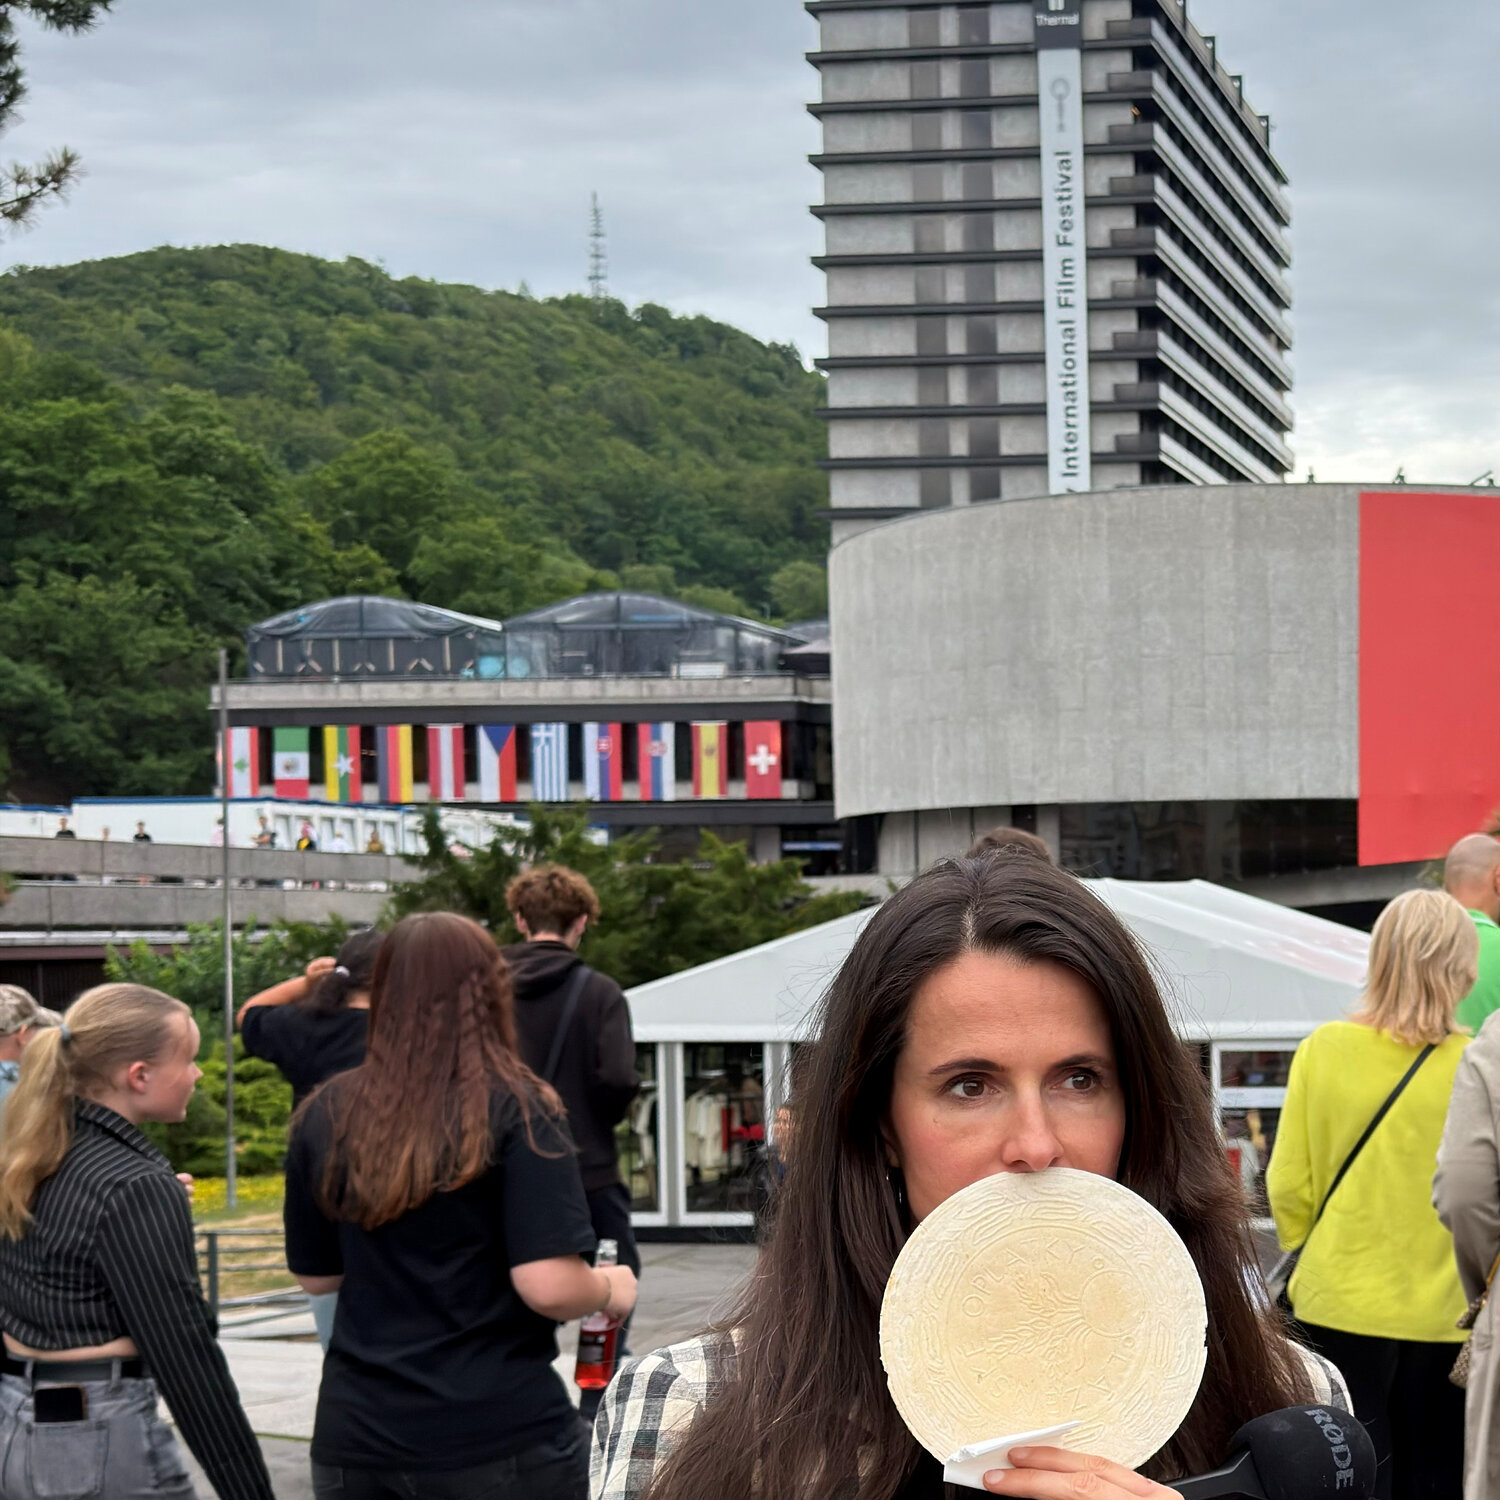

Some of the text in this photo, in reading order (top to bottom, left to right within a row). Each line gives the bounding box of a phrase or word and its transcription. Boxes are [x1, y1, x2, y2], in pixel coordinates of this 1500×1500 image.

[1053, 151, 1074, 248] Festival
[1056, 258, 1076, 308] Film
[1057, 319, 1079, 478] International
[961, 1237, 1086, 1317] OPLATKY
